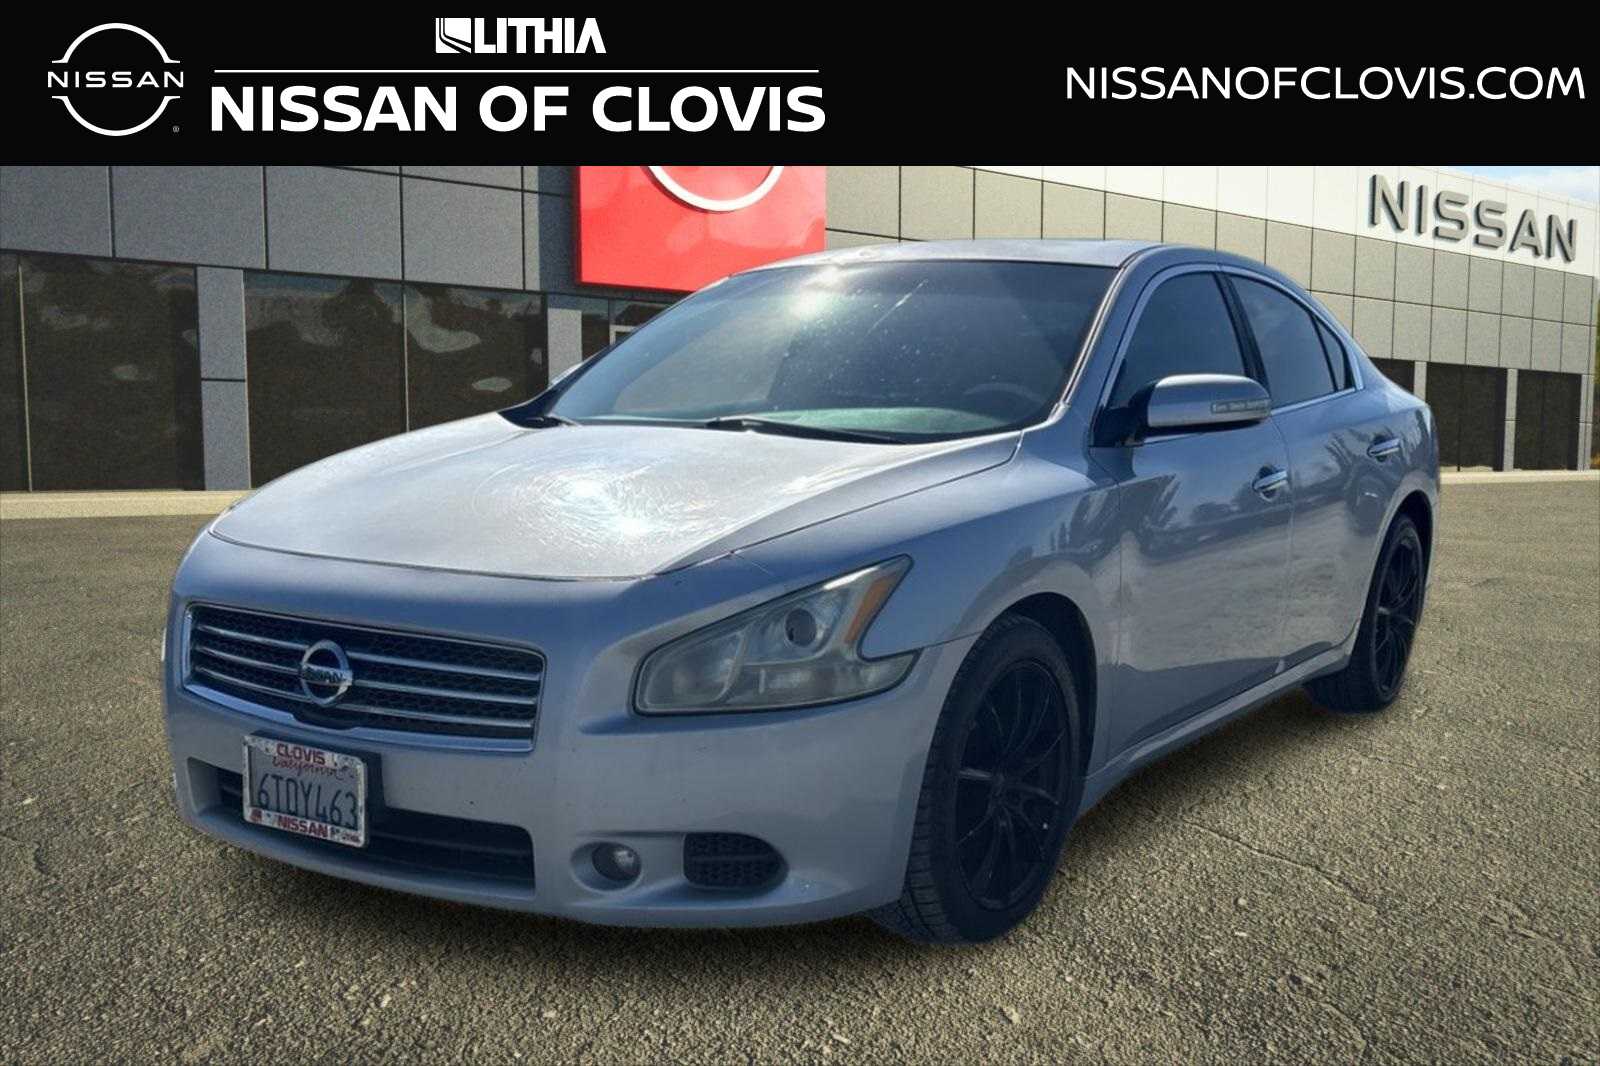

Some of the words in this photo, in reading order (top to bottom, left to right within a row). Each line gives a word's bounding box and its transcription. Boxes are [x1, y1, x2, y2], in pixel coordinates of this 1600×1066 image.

[1368, 173, 1577, 263] NISSAN
[277, 743, 326, 765] CLOVIS
[277, 815, 329, 839] NISSAN
